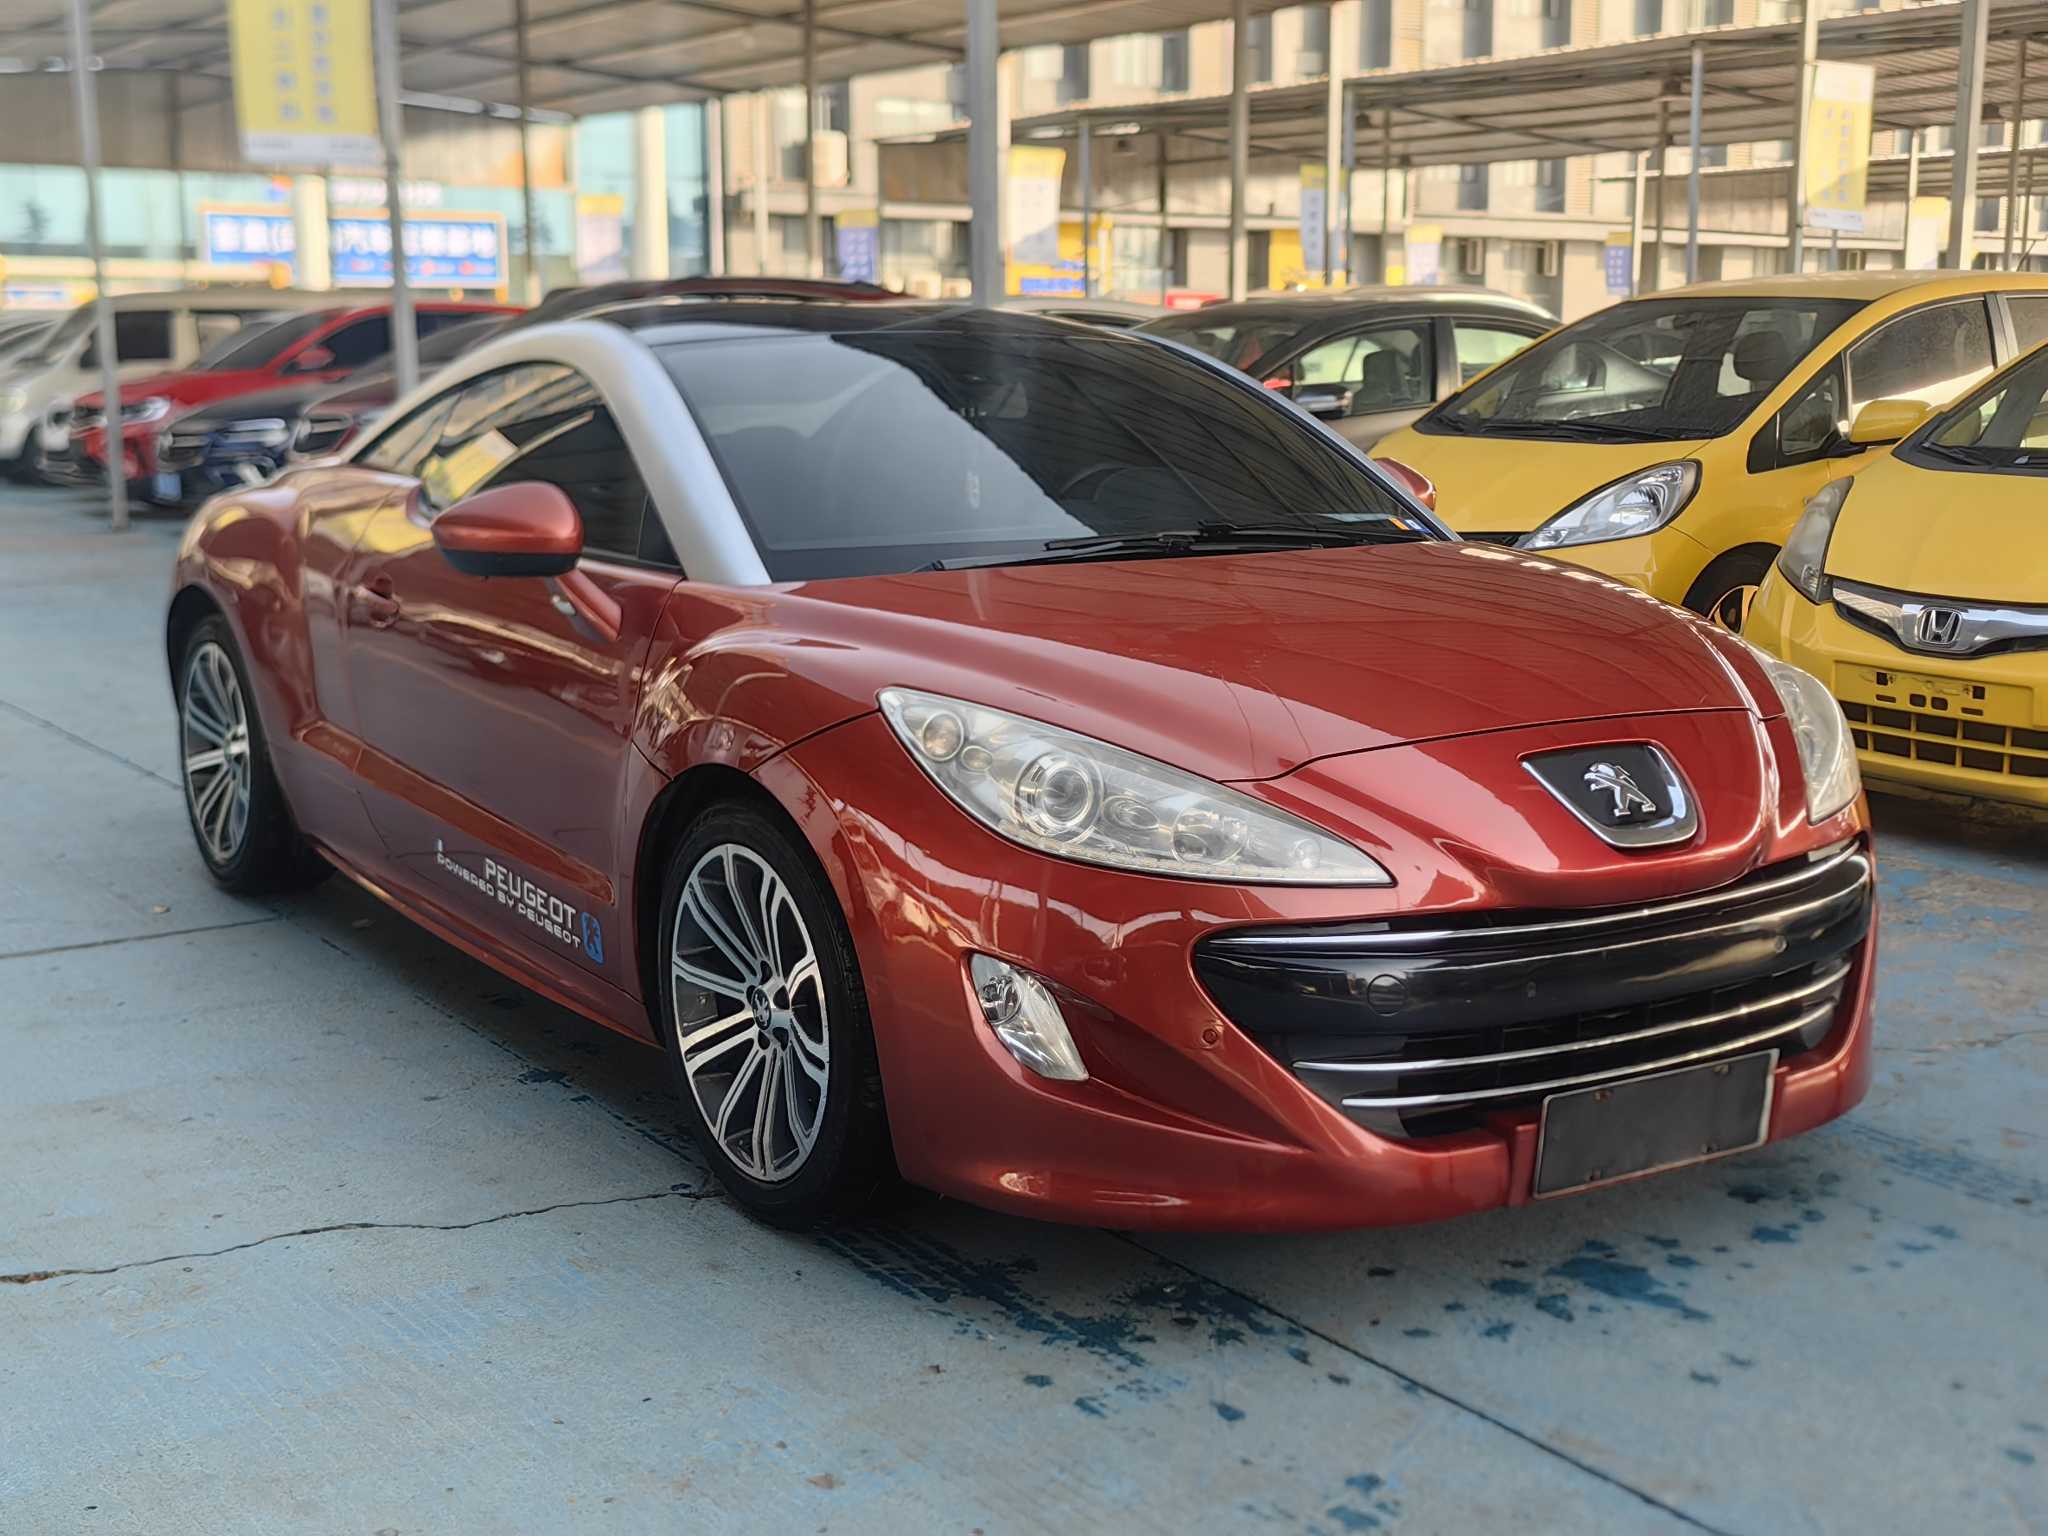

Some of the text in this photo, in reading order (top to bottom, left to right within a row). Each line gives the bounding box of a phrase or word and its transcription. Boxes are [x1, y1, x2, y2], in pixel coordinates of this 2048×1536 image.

[437, 853, 581, 948] POWERED BY PEUGEOT
[485, 858, 576, 929] PEUGEOT
